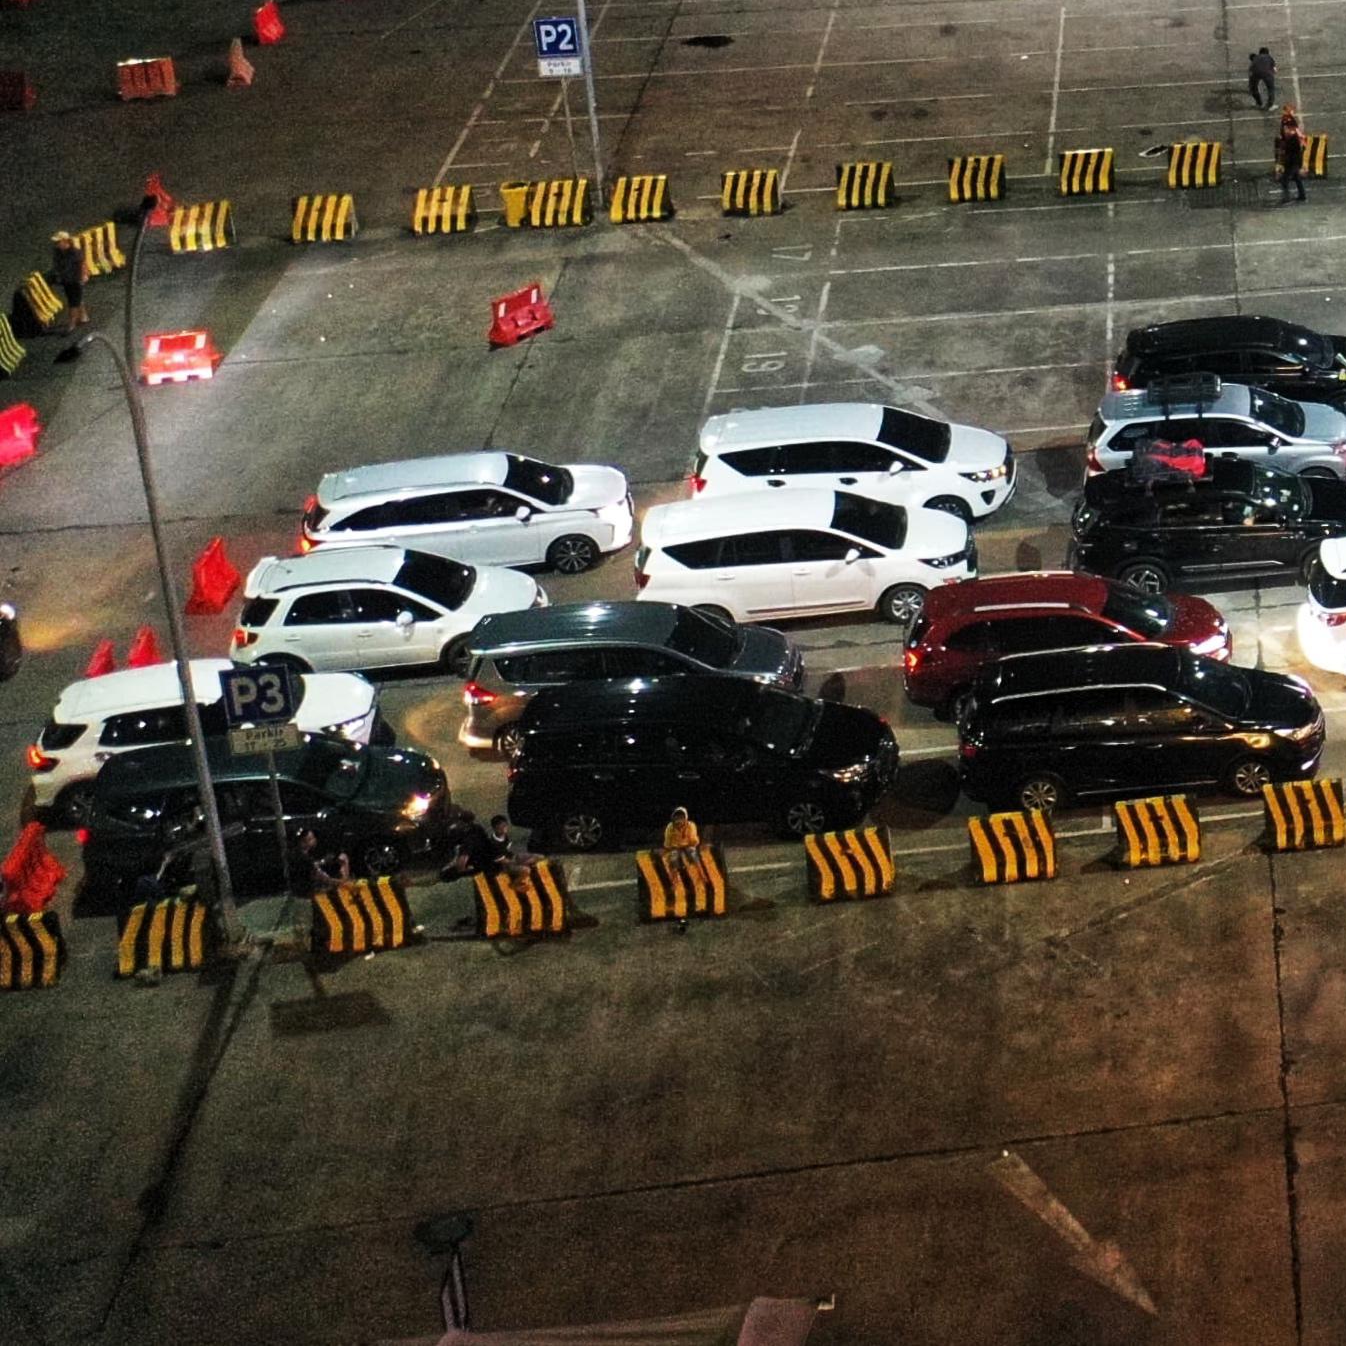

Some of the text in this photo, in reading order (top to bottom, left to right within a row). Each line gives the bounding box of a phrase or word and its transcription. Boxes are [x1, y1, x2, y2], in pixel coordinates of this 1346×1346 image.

[540, 24, 574, 51] P2
[741, 351, 787, 373] 19
[230, 674, 286, 716] P3
